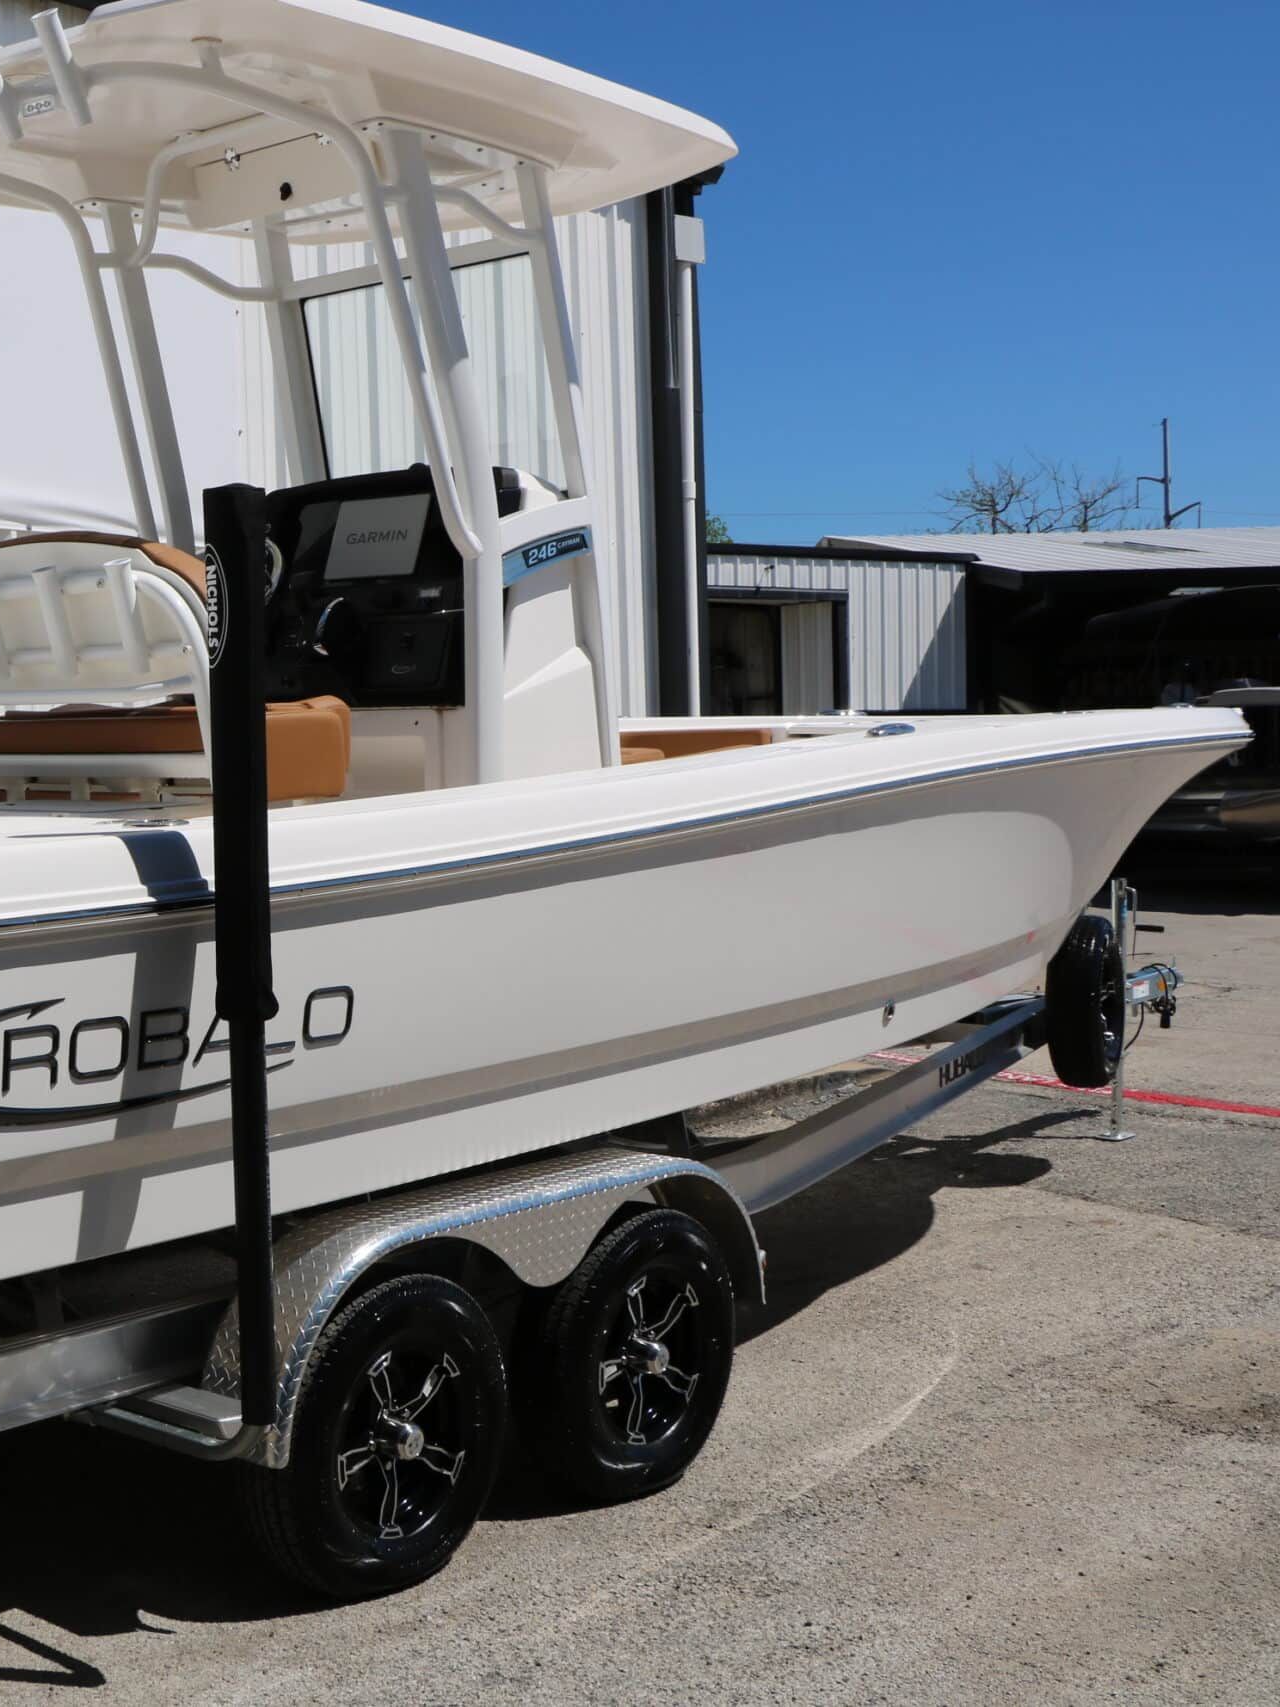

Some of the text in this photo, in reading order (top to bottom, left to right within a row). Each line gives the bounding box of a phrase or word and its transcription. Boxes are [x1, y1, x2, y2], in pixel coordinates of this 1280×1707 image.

[346, 528, 409, 545] GARMIN
[527, 541, 557, 566] 246
[205, 564, 220, 648] NICHOLS
[0, 984, 354, 1098] ROBO
